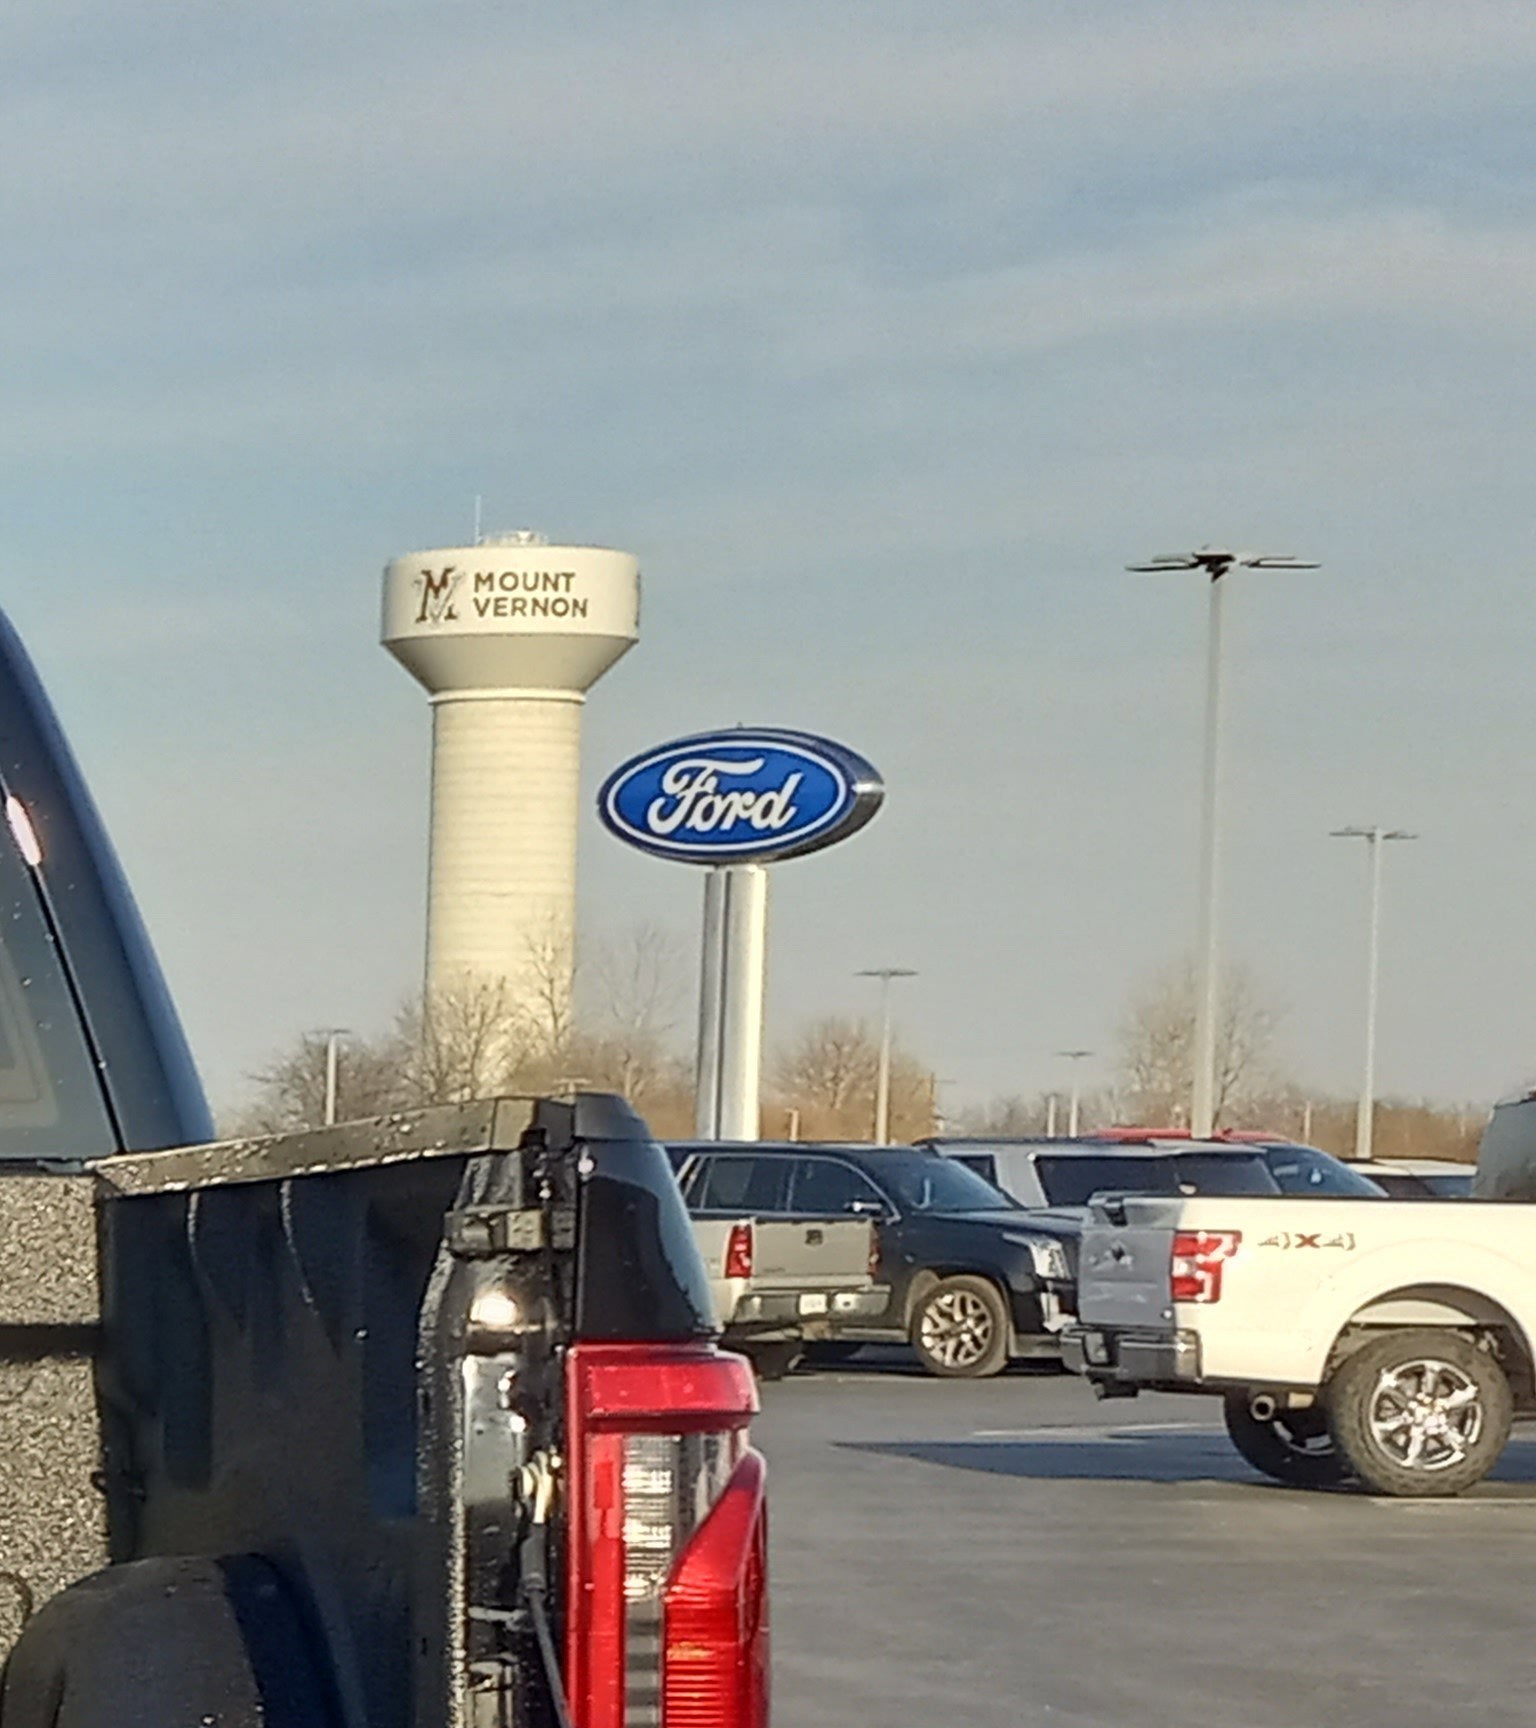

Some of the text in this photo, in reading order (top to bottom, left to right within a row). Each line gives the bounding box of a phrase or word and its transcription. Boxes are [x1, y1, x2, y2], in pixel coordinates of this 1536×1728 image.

[473, 571, 576, 594] MOUNT
[472, 596, 589, 619] VERNON
[646, 757, 804, 834] Ford
